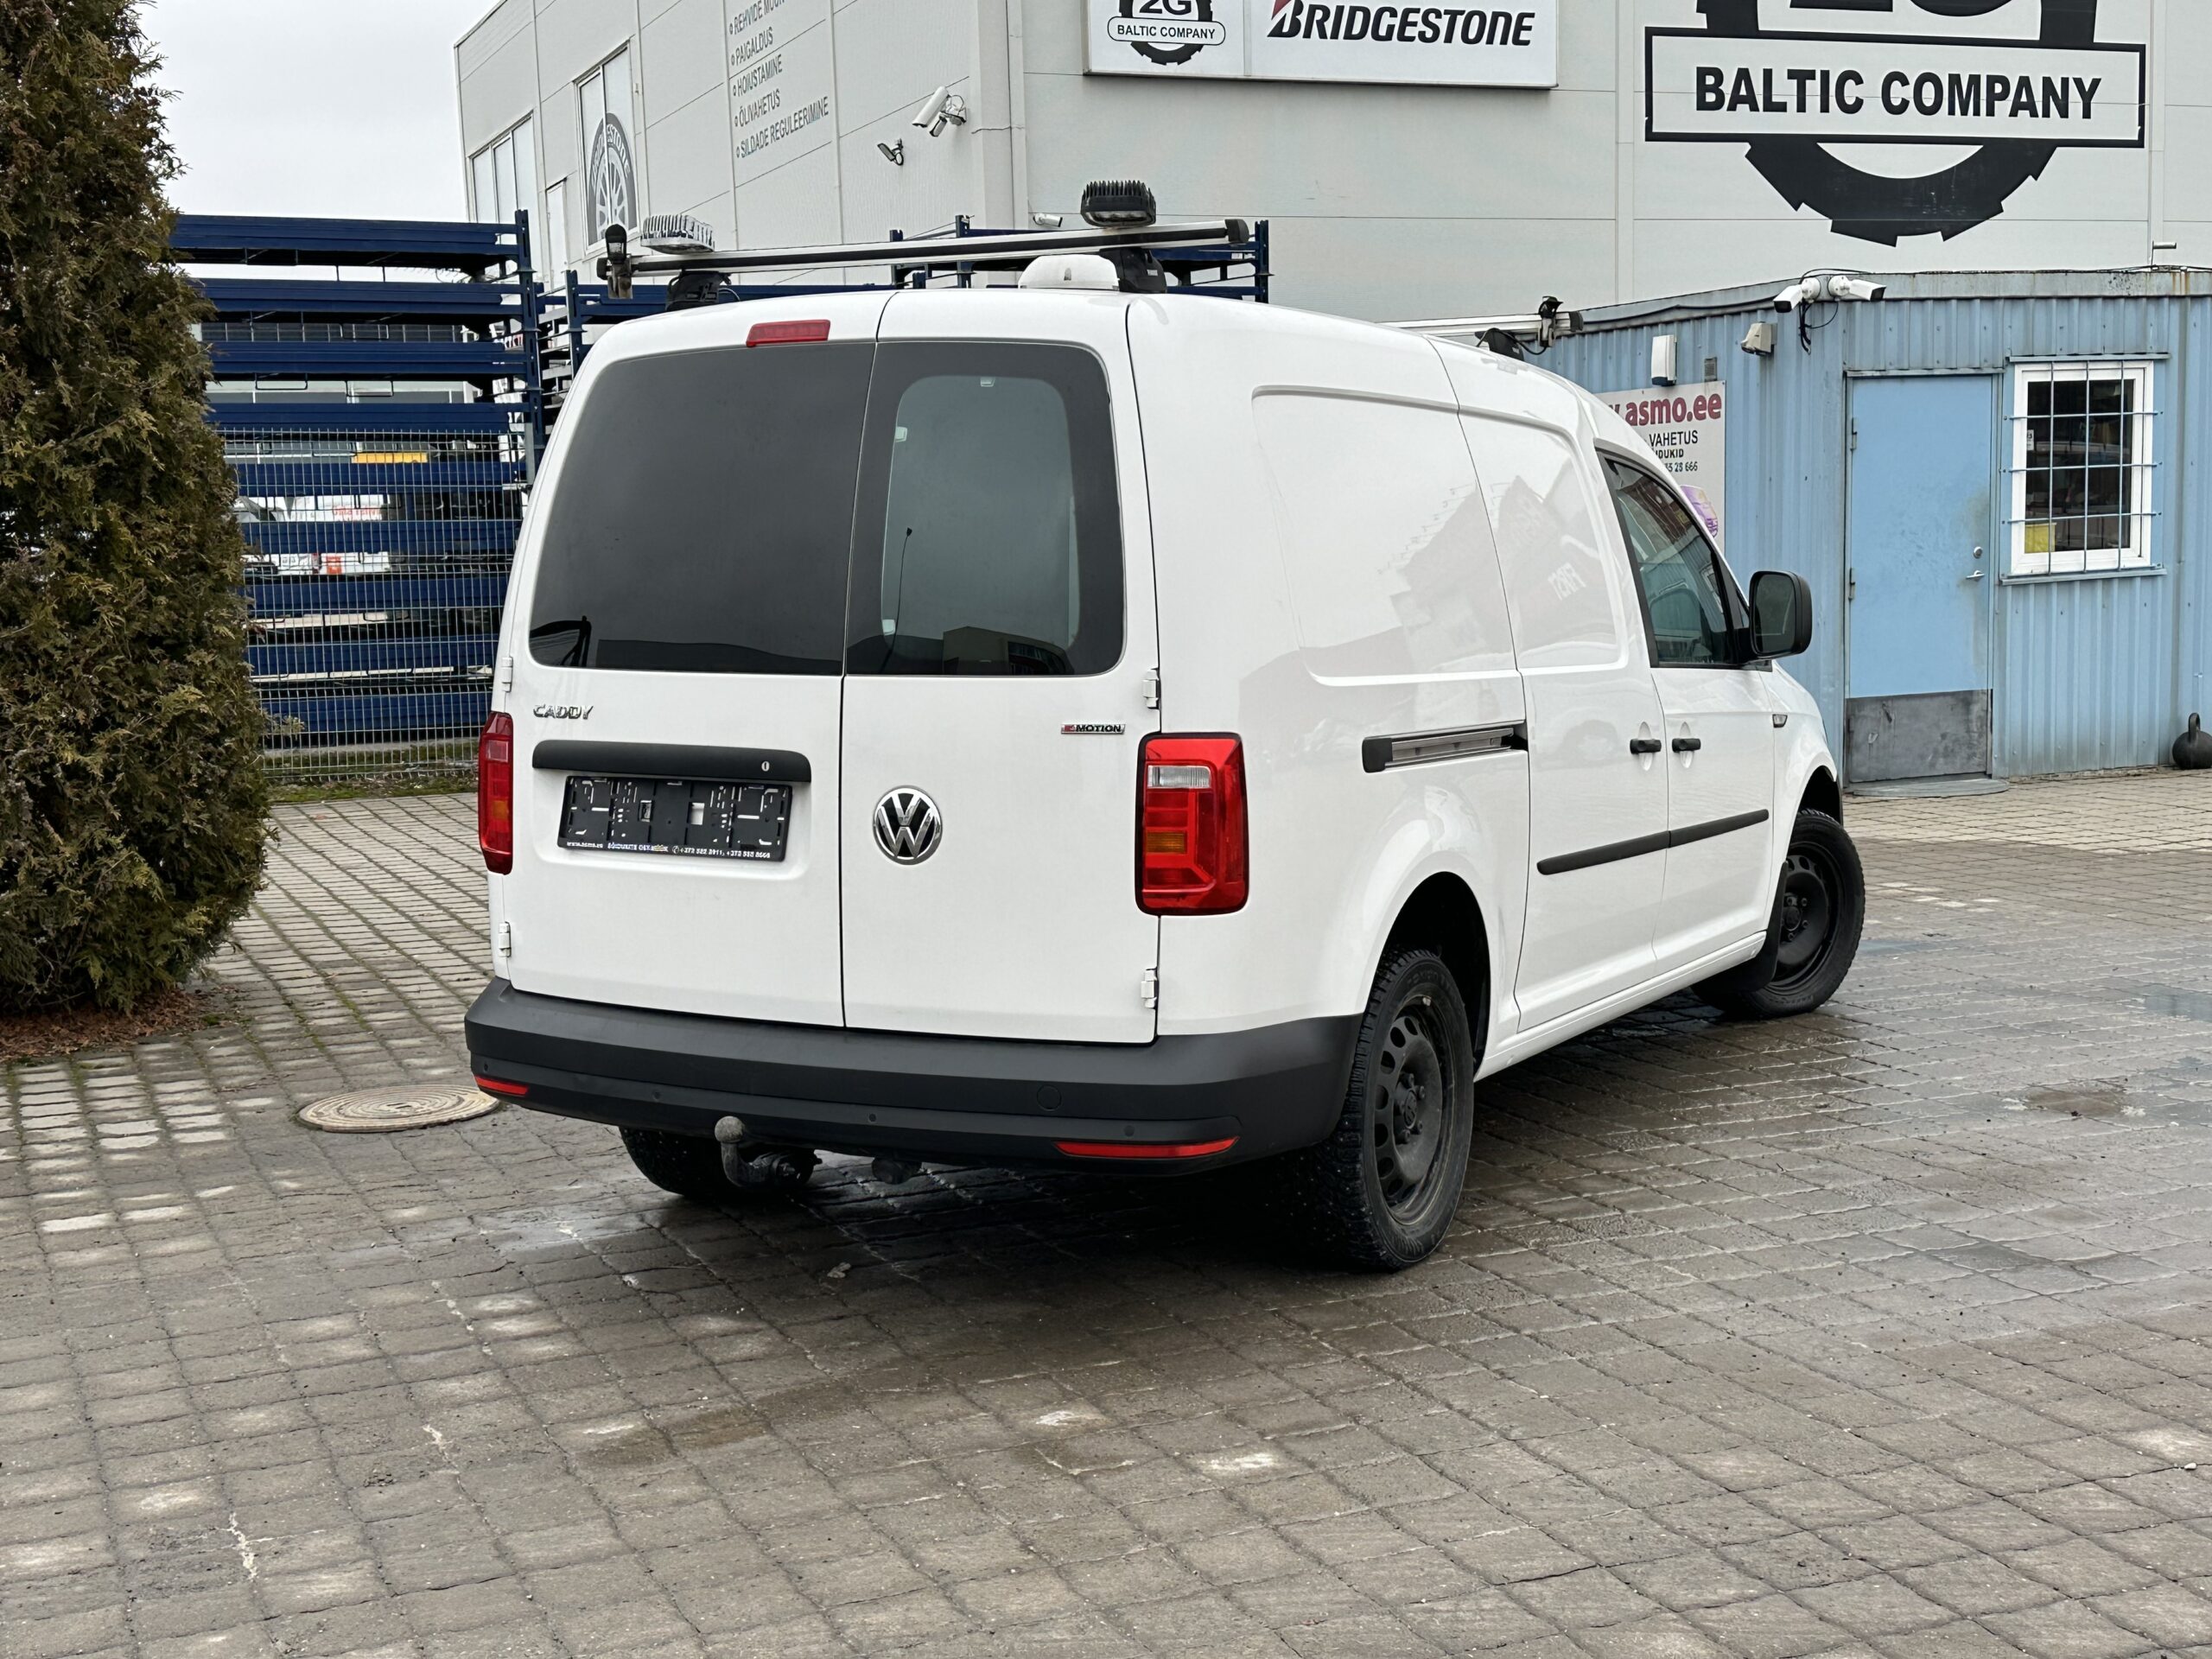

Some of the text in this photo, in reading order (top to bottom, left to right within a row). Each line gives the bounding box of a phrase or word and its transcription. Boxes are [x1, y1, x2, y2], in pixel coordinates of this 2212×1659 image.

[1117, 24, 1216, 40] BALTIC COMPANY
[1267, 0, 1535, 47] BRIDGESTONE
[735, 26, 773, 66] PAIGALDUS
[737, 54, 783, 97] HOIUSTAMINE
[1696, 66, 2101, 119] BALTIC COMPANY
[739, 88, 780, 127] ÕLIVAHETUS
[741, 96, 830, 158] SILDADE REGULEERIMINE
[533, 704, 594, 720] CADDY
